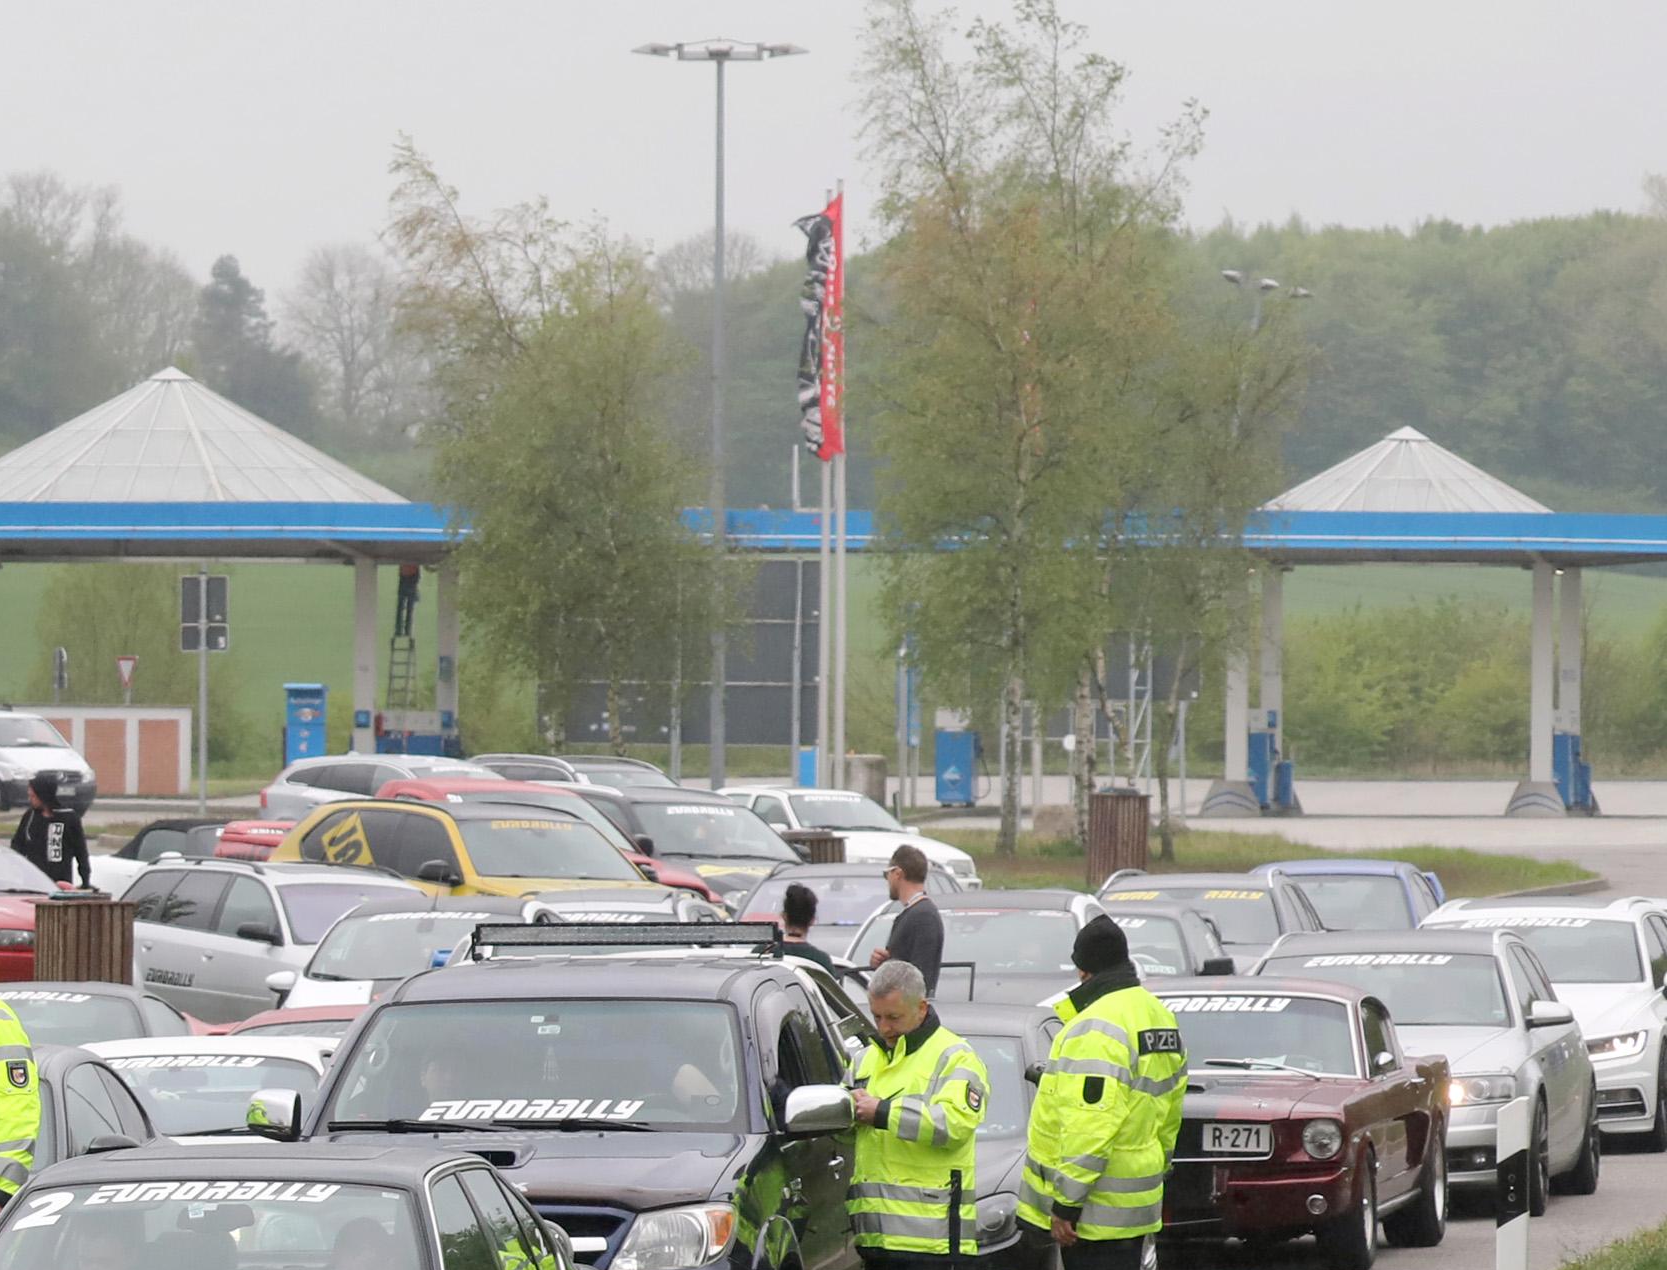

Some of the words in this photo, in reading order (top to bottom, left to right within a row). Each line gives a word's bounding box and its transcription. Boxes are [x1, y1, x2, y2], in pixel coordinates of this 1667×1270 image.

[1303, 953, 1453, 968] EURORALLY
[1161, 996, 1292, 1013] RORALLY
[417, 1099, 643, 1121] EURORALLY
[1212, 1127, 1261, 1149] R-271
[12, 1191, 75, 1232] 2
[84, 1181, 343, 1207] EURORALLY
